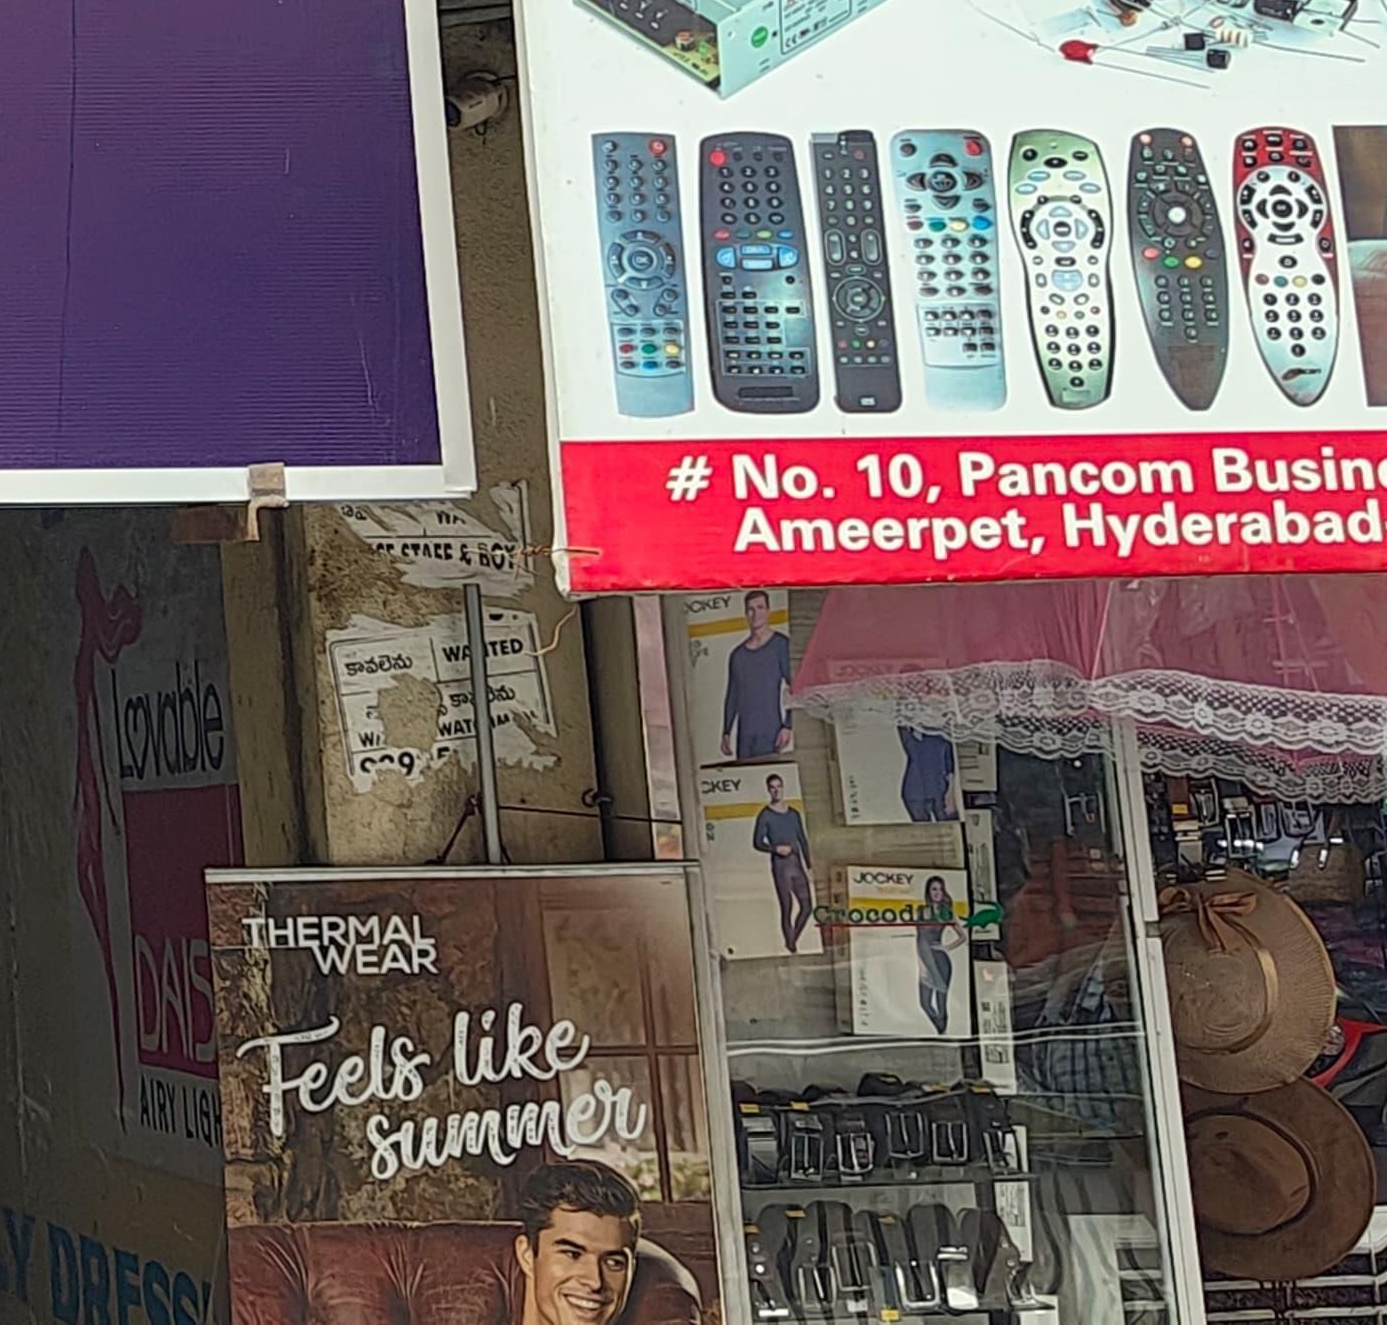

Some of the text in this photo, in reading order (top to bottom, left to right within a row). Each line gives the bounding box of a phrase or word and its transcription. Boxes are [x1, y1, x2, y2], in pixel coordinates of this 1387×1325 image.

[665, 455, 713, 502] #
[730, 453, 835, 500] No.
[857, 452, 942, 507] 10,
[960, 450, 1195, 497] Pancom
[733, 497, 1384, 560] Ameerpet, Hyderabad
[111, 660, 225, 782] Lovable
[853, 872, 915, 886] JOCKEY
[241, 915, 436, 949] THERMAL
[313, 943, 439, 974] WEAR
[236, 1002, 591, 1138] Feels like
[140, 1074, 176, 1133] AIRY
[365, 1078, 647, 1180] summer
